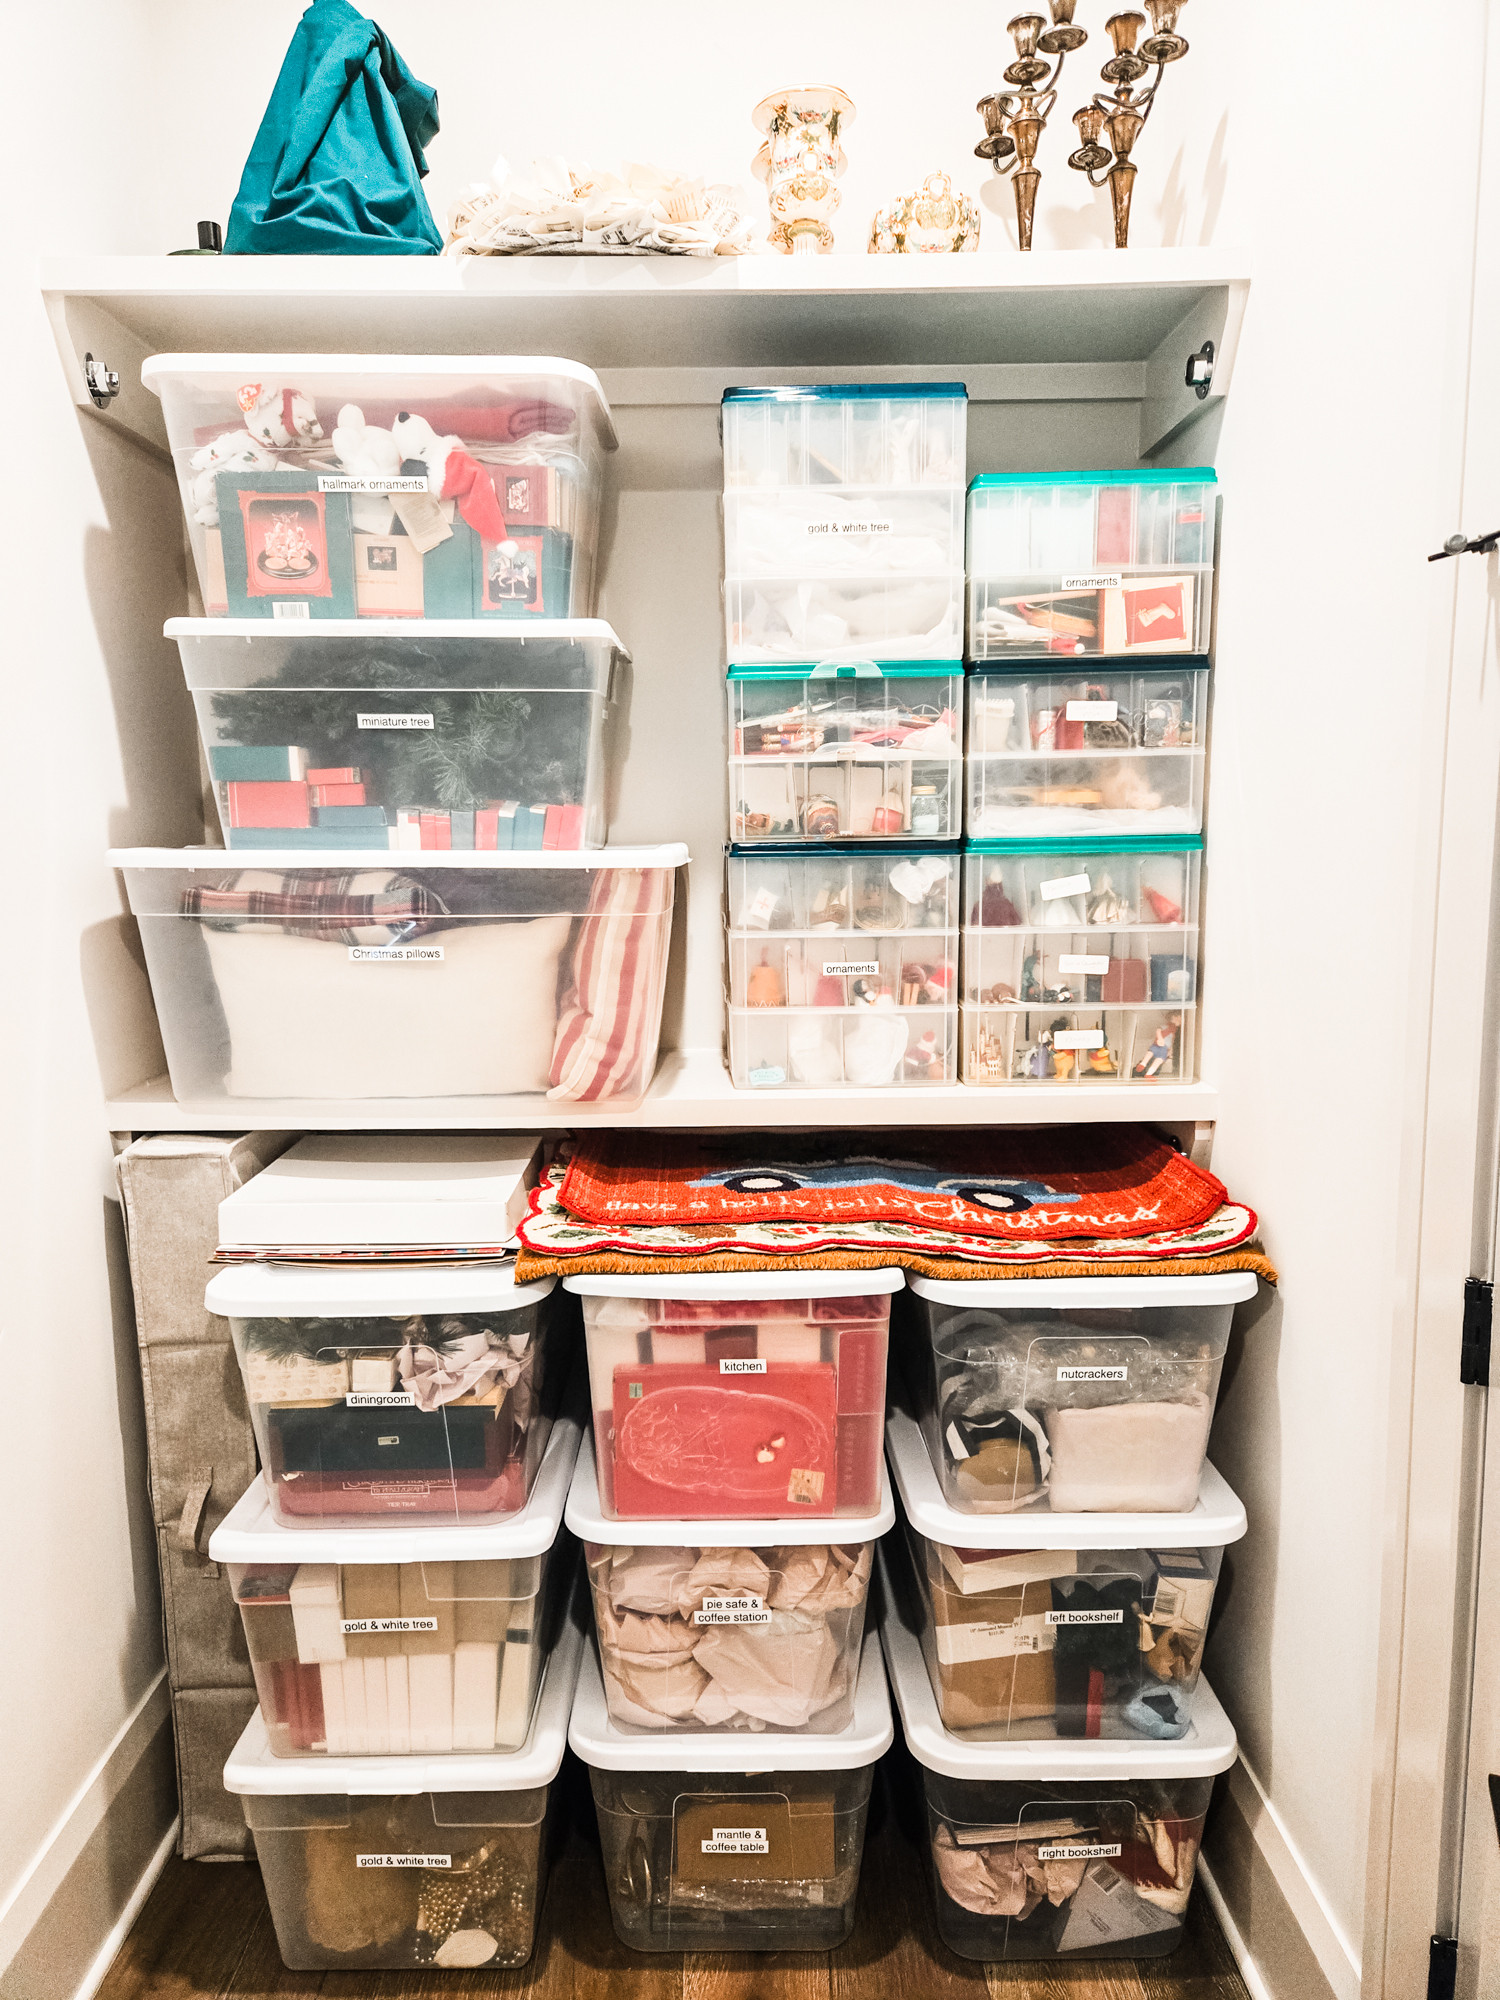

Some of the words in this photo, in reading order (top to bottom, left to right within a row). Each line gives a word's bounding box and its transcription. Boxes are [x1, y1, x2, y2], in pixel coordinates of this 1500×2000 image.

[322, 480, 366, 490] hallmark
[369, 481, 424, 490] ornaments
[807, 524, 828, 535] gold
[831, 523, 839, 532] &
[842, 524, 868, 532] white
[870, 523, 890, 531] tree
[1065, 577, 1118, 588] ornaments
[361, 717, 408, 727] miniature
[411, 718, 430, 727] tree
[352, 949, 404, 960] Christmas
[406, 949, 441, 960] pillows
[826, 965, 876, 974] ornaments
[689, 1200, 710, 1210] a
[721, 1195, 811, 1210] holly
[824, 1195, 909, 1212] jolly
[914, 1198, 1162, 1230] Christmas
[724, 1362, 764, 1371] kitchen
[1061, 1369, 1124, 1379] nutcrackers
[350, 1395, 411, 1406] diningroom
[706, 1600, 723, 1610] pie
[725, 1599, 748, 1609] safe
[750, 1599, 759, 1609] &
[698, 1613, 731, 1622] coffee
[733, 1612, 768, 1622] station
[1049, 1613, 1066, 1622] left
[1068, 1611, 1120, 1622] bookshelf
[344, 1622, 367, 1632] gold
[370, 1621, 379, 1630] &
[381, 1620, 410, 1630] white
[412, 1620, 434, 1629] tree
[716, 1830, 752, 1839] mantle
[754, 1830, 762, 1839] &
[705, 1843, 737, 1852] coffee
[740, 1843, 765, 1852] table
[1042, 1849, 1066, 1859] right
[1068, 1846, 1118, 1857] bookshelf
[360, 1857, 383, 1866] gold
[386, 1856, 394, 1866] &
[396, 1857, 424, 1866] white
[427, 1857, 448, 1866] tree
